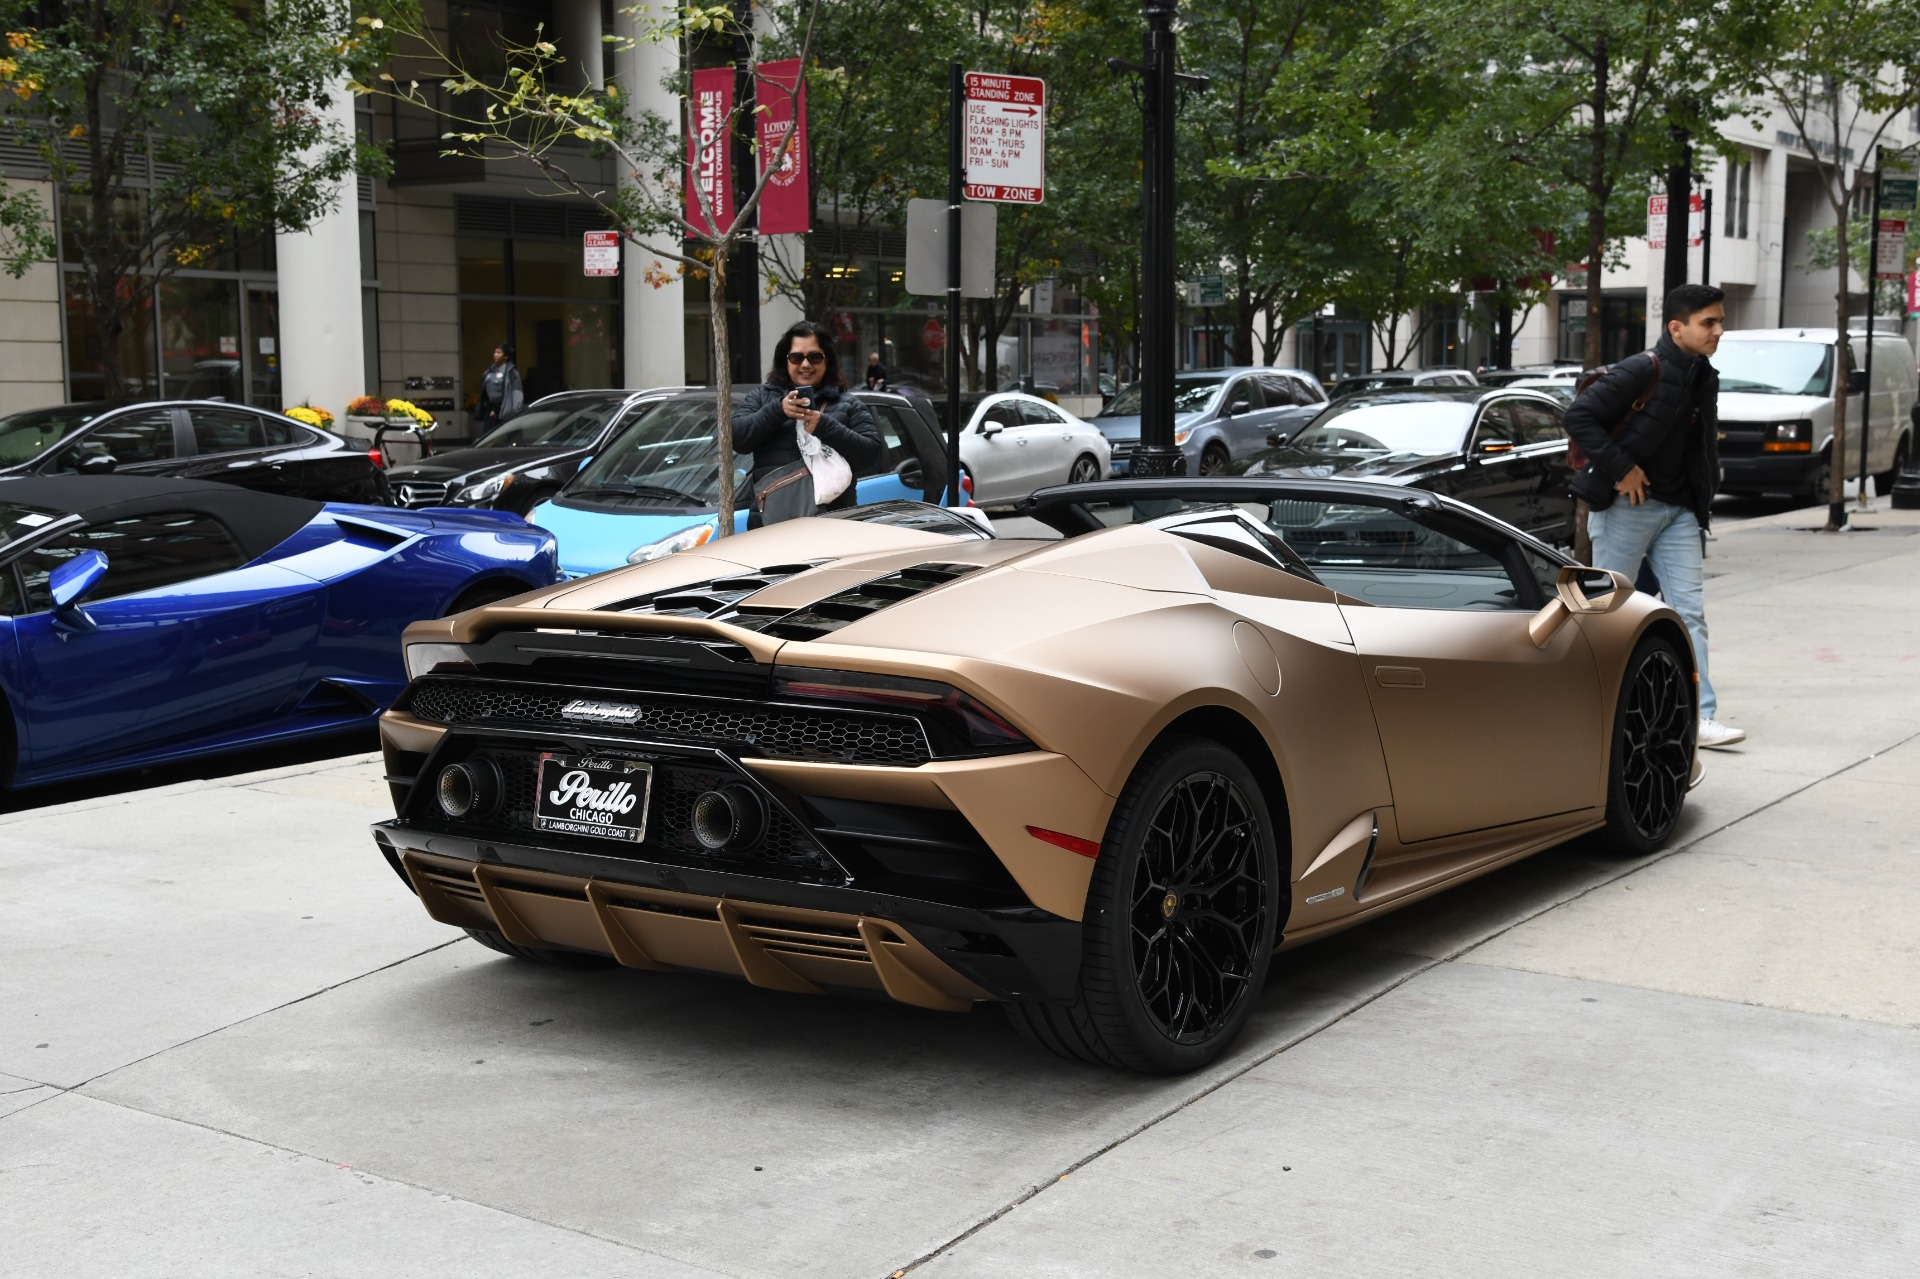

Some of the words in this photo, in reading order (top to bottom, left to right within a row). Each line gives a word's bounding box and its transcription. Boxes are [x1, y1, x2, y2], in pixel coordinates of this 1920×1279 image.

[970, 76, 979, 86] 15
[981, 78, 1012, 89] MINUTE
[970, 88, 1010, 100] STANDING
[1014, 92, 1036, 102] ZONE
[970, 105, 986, 114] USE
[970, 116, 1010, 127] FLASHING
[1012, 119, 1039, 129] LIGHTS
[970, 126, 979, 135] 10
[980, 126, 993, 136] AM
[1002, 128, 1006, 137] 8
[1010, 129, 1021, 138] PM
[970, 136, 988, 146] MON
[998, 138, 1025, 149] THURS
[970, 147, 978, 155] 10
[980, 147, 992, 156] AM
[1000, 149, 1006, 158] 6
[1008, 150, 1020, 159] PM
[970, 157, 983, 166] FRI
[991, 159, 1009, 168] SUN
[970, 185, 996, 198] TOW
[1003, 187, 1036, 201] ZONE
[562, 700, 639, 719] Lamborghini
[578, 758, 613, 769] Perillo
[550, 770, 636, 814] Perillo
[570, 808, 613, 824] CHICAGO
[549, 821, 589, 833] LAMBORGHINI
[590, 827, 606, 836] GOLD
[608, 829, 626, 838] COAST
